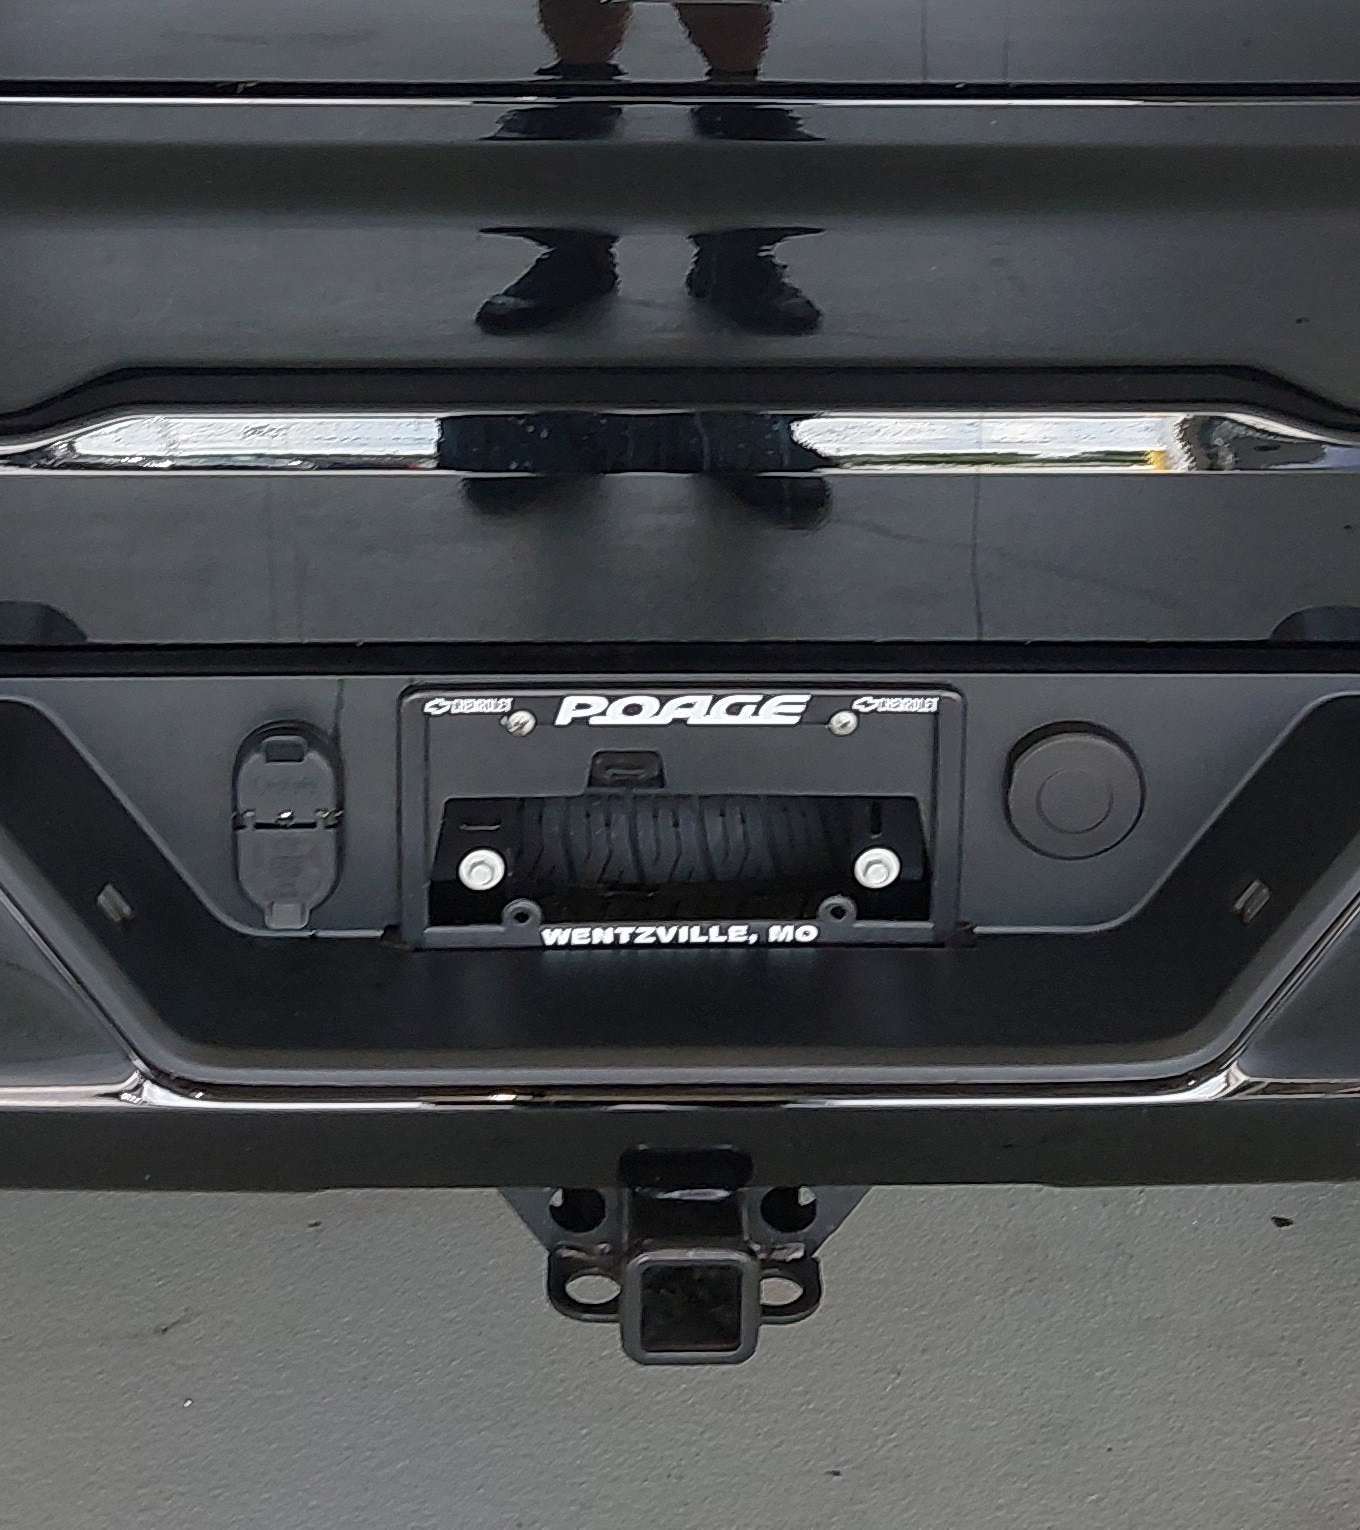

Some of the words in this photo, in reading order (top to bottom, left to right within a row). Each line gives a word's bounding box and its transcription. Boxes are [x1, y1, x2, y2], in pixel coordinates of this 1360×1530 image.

[553, 693, 812, 727] POAGE
[540, 923, 759, 946] WENTZVILLE,
[767, 923, 819, 943] MO
